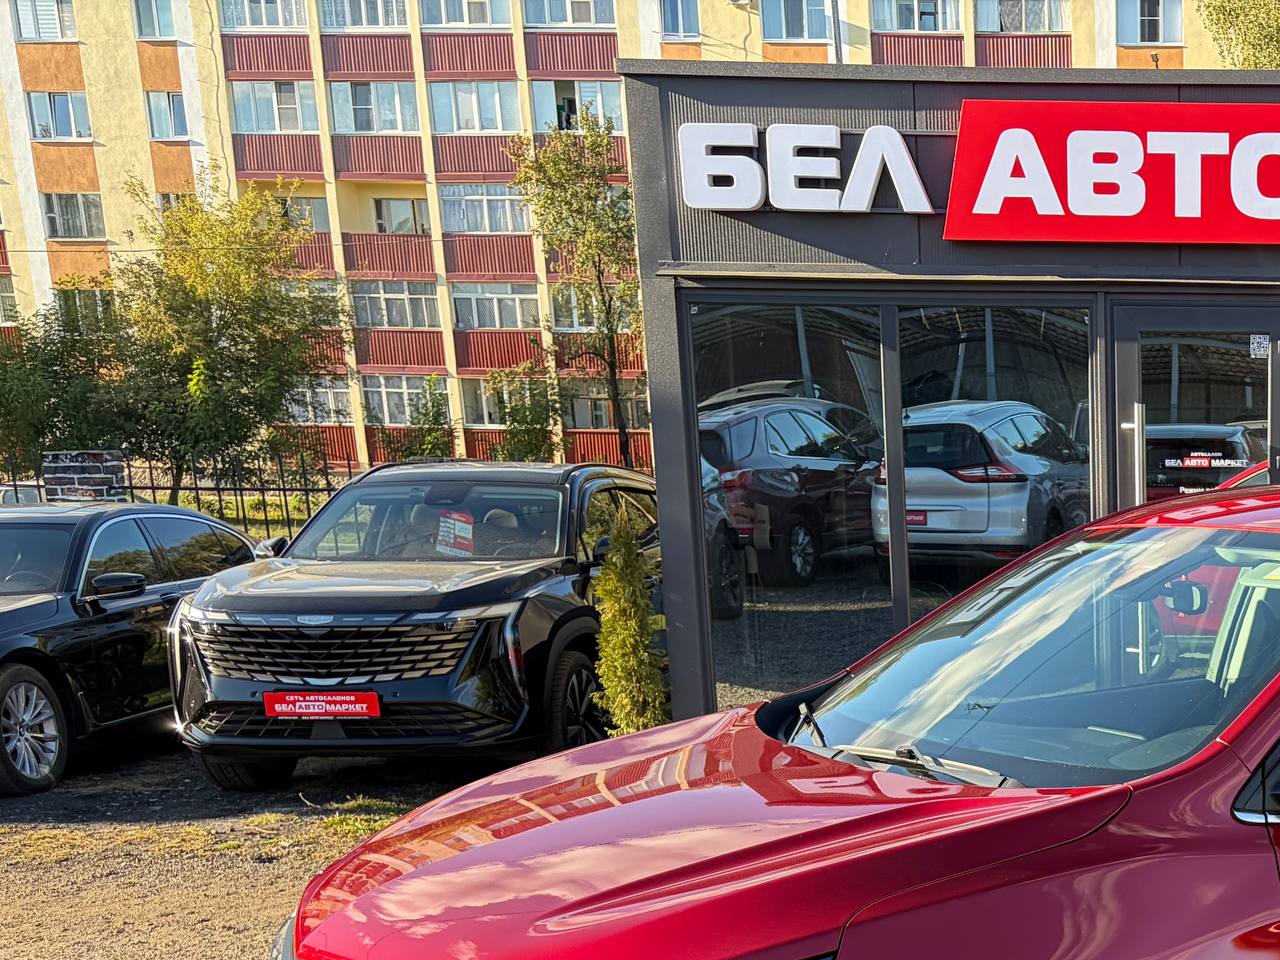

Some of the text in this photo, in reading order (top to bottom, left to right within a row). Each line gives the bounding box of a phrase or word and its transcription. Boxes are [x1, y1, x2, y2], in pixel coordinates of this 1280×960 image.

[678, 122, 935, 213] БЕЛ
[1165, 459, 1248, 467] БЕЛ АВТО МАРКЕТ
[296, 703, 325, 712] АВТО
[326, 704, 368, 712] МАРКЕТ
